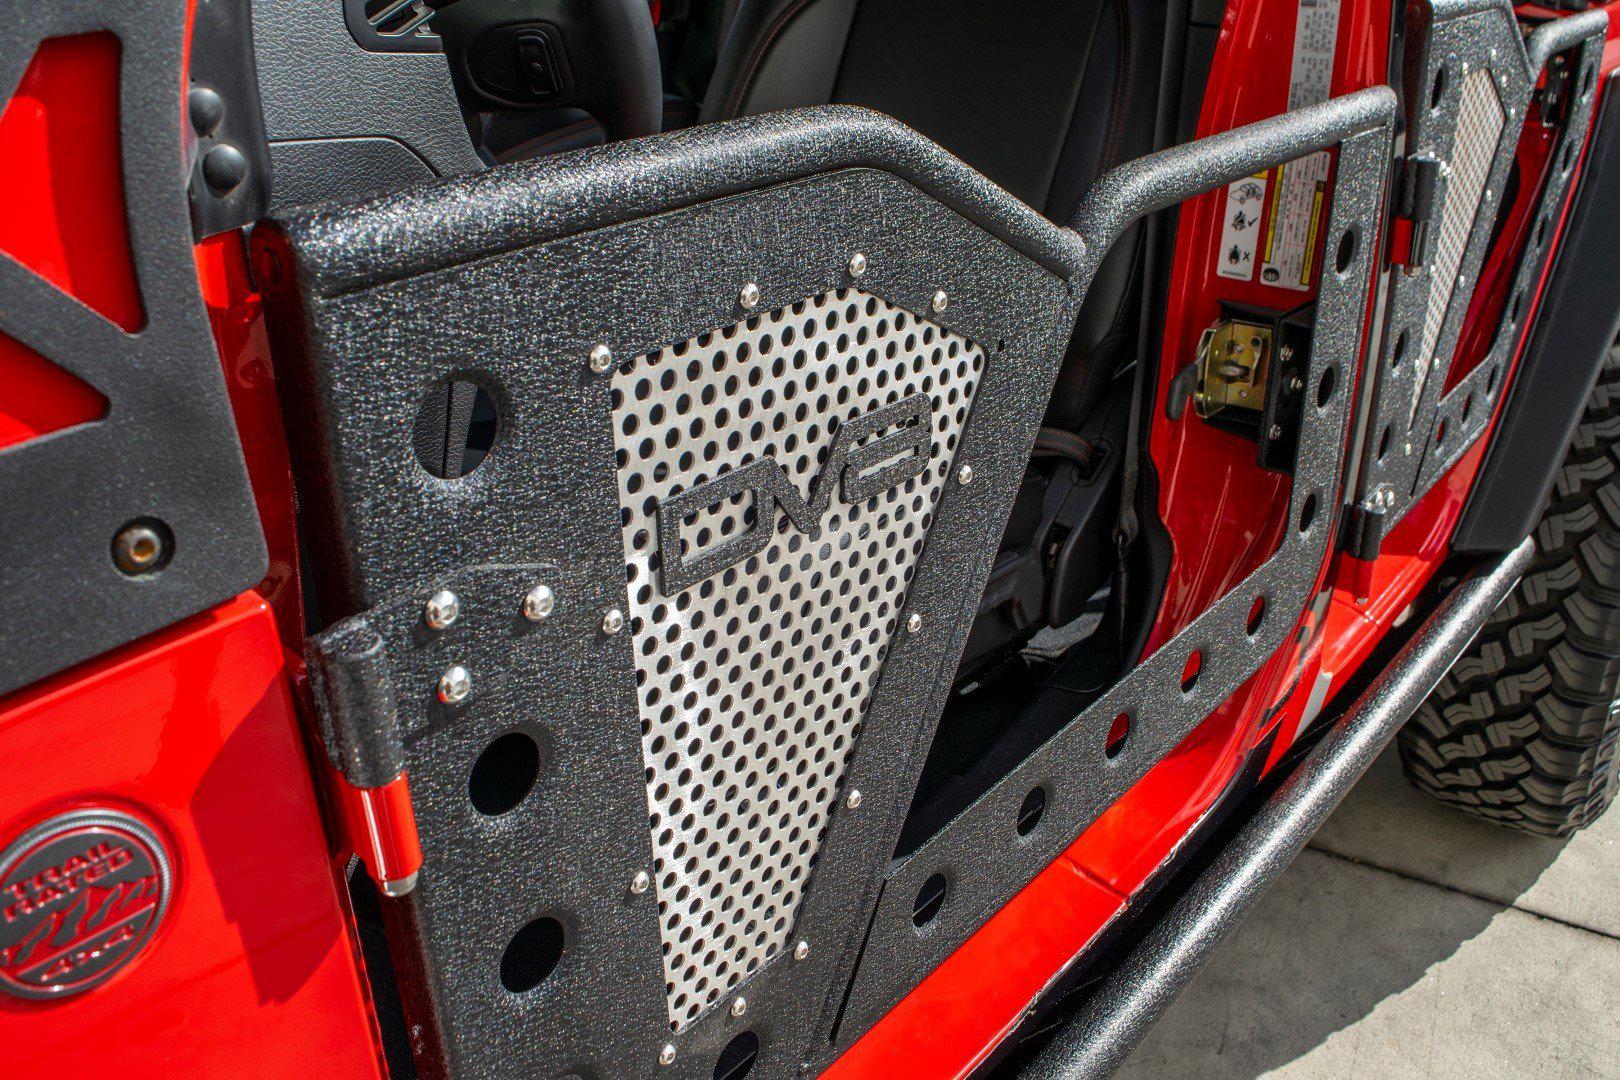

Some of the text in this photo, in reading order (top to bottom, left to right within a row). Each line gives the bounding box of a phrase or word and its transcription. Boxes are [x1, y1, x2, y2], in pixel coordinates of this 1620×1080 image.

[655, 392, 932, 597] DV8
[3, 843, 125, 899] TRAIL
[3, 850, 133, 923] RATED
